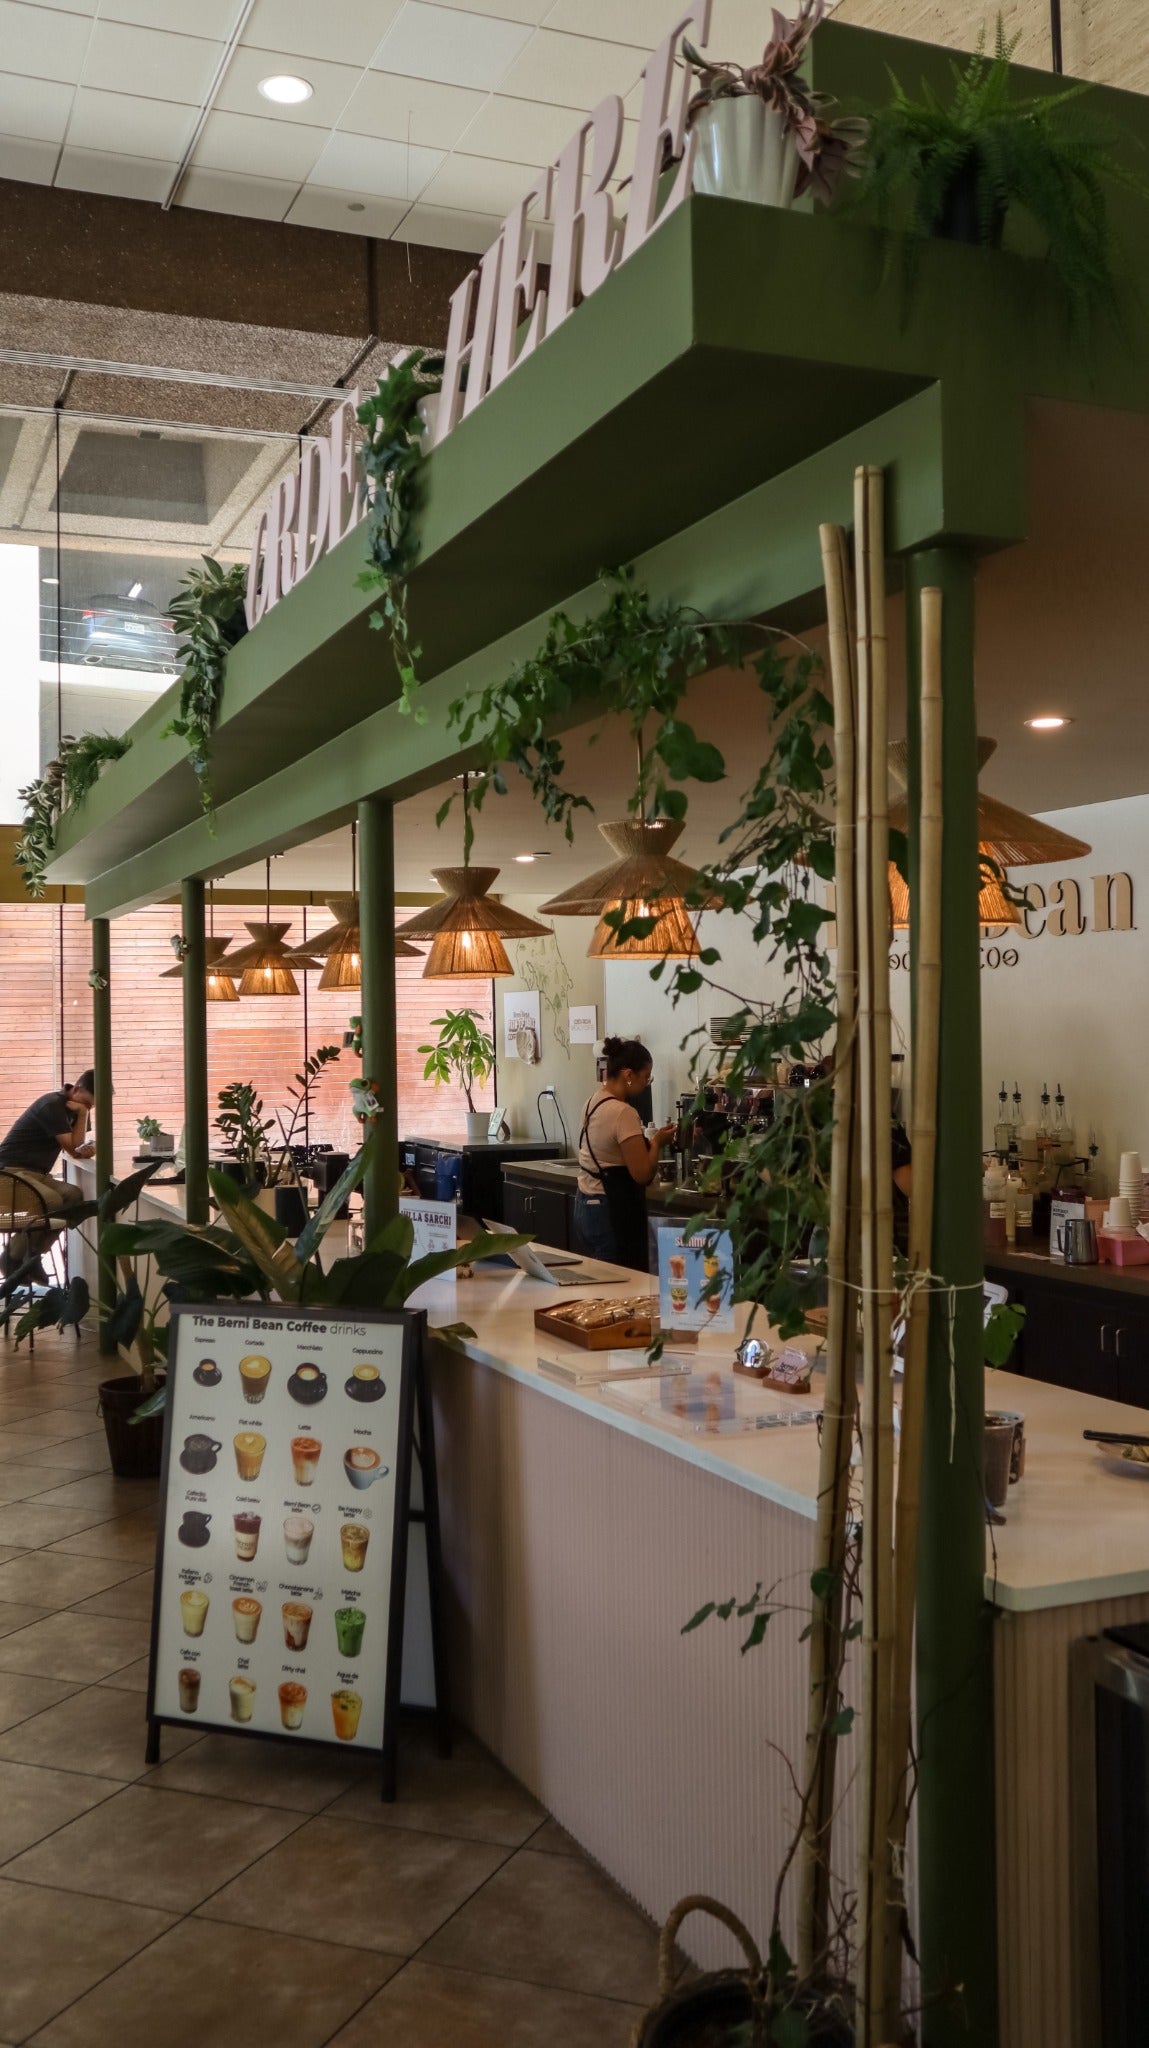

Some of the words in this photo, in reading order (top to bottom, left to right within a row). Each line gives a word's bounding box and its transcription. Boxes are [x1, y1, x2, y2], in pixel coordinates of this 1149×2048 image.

[435, 0, 714, 450] HERE
[424, 1213, 451, 1226] SARCHI
[192, 1315, 215, 1327] The
[217, 1317, 250, 1329] Berni
[252, 1319, 283, 1331] Bean
[287, 1322, 327, 1334] Coffee
[329, 1324, 367, 1337] drinks
[352, 1348, 384, 1357] Cappuccino
[189, 1414, 216, 1422] Americano
[281, 1664, 295, 1674] Dirty
